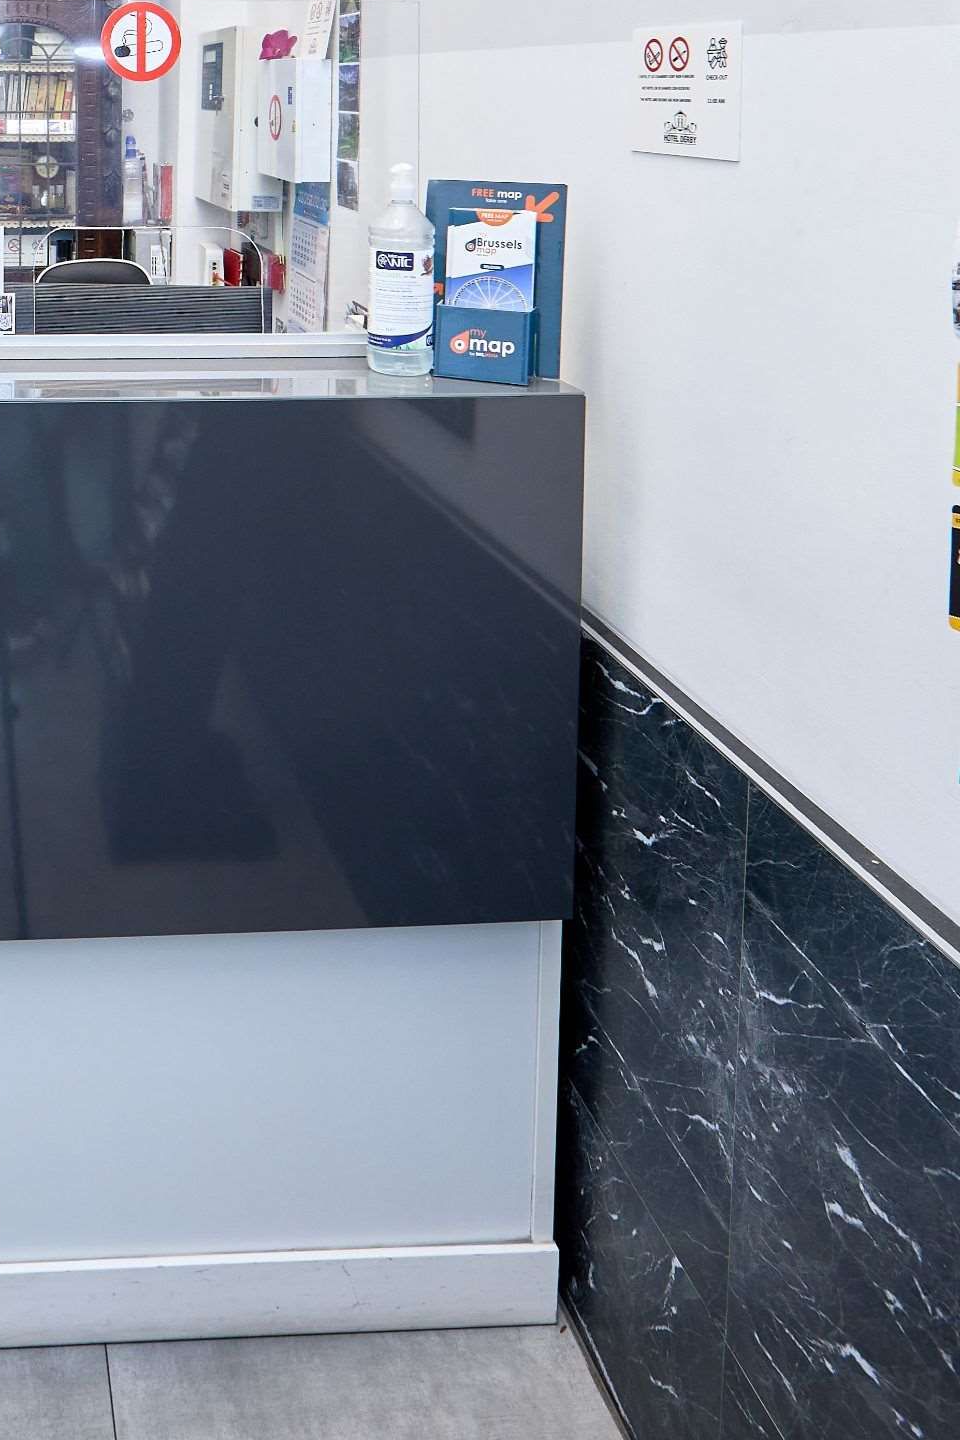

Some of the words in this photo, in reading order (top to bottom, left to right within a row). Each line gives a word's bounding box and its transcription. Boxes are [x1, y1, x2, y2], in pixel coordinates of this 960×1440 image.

[664, 134, 679, 143] HOTEL
[680, 135, 696, 144] DERBY
[471, 187, 495, 198] FREE
[497, 190, 522, 201] map
[477, 237, 523, 250] Brussels
[476, 248, 497, 256] map
[470, 328, 487, 339] my
[469, 338, 515, 358] map
